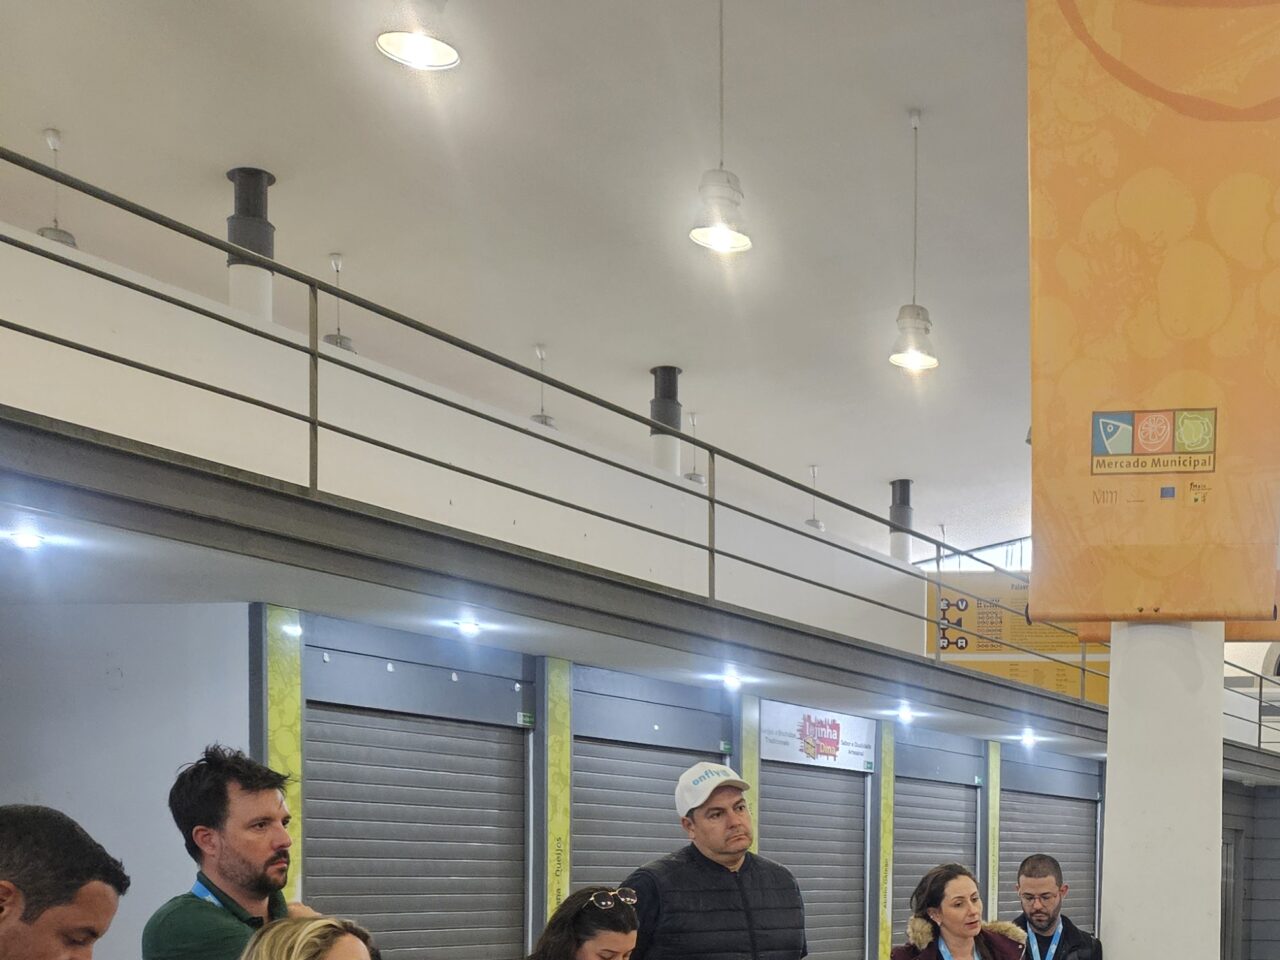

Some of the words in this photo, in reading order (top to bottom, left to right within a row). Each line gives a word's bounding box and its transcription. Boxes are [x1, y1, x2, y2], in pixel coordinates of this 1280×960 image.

[1095, 458, 1148, 469] Mercado
[1150, 455, 1212, 470] Municipal
[555, 836, 563, 877] Queijos
